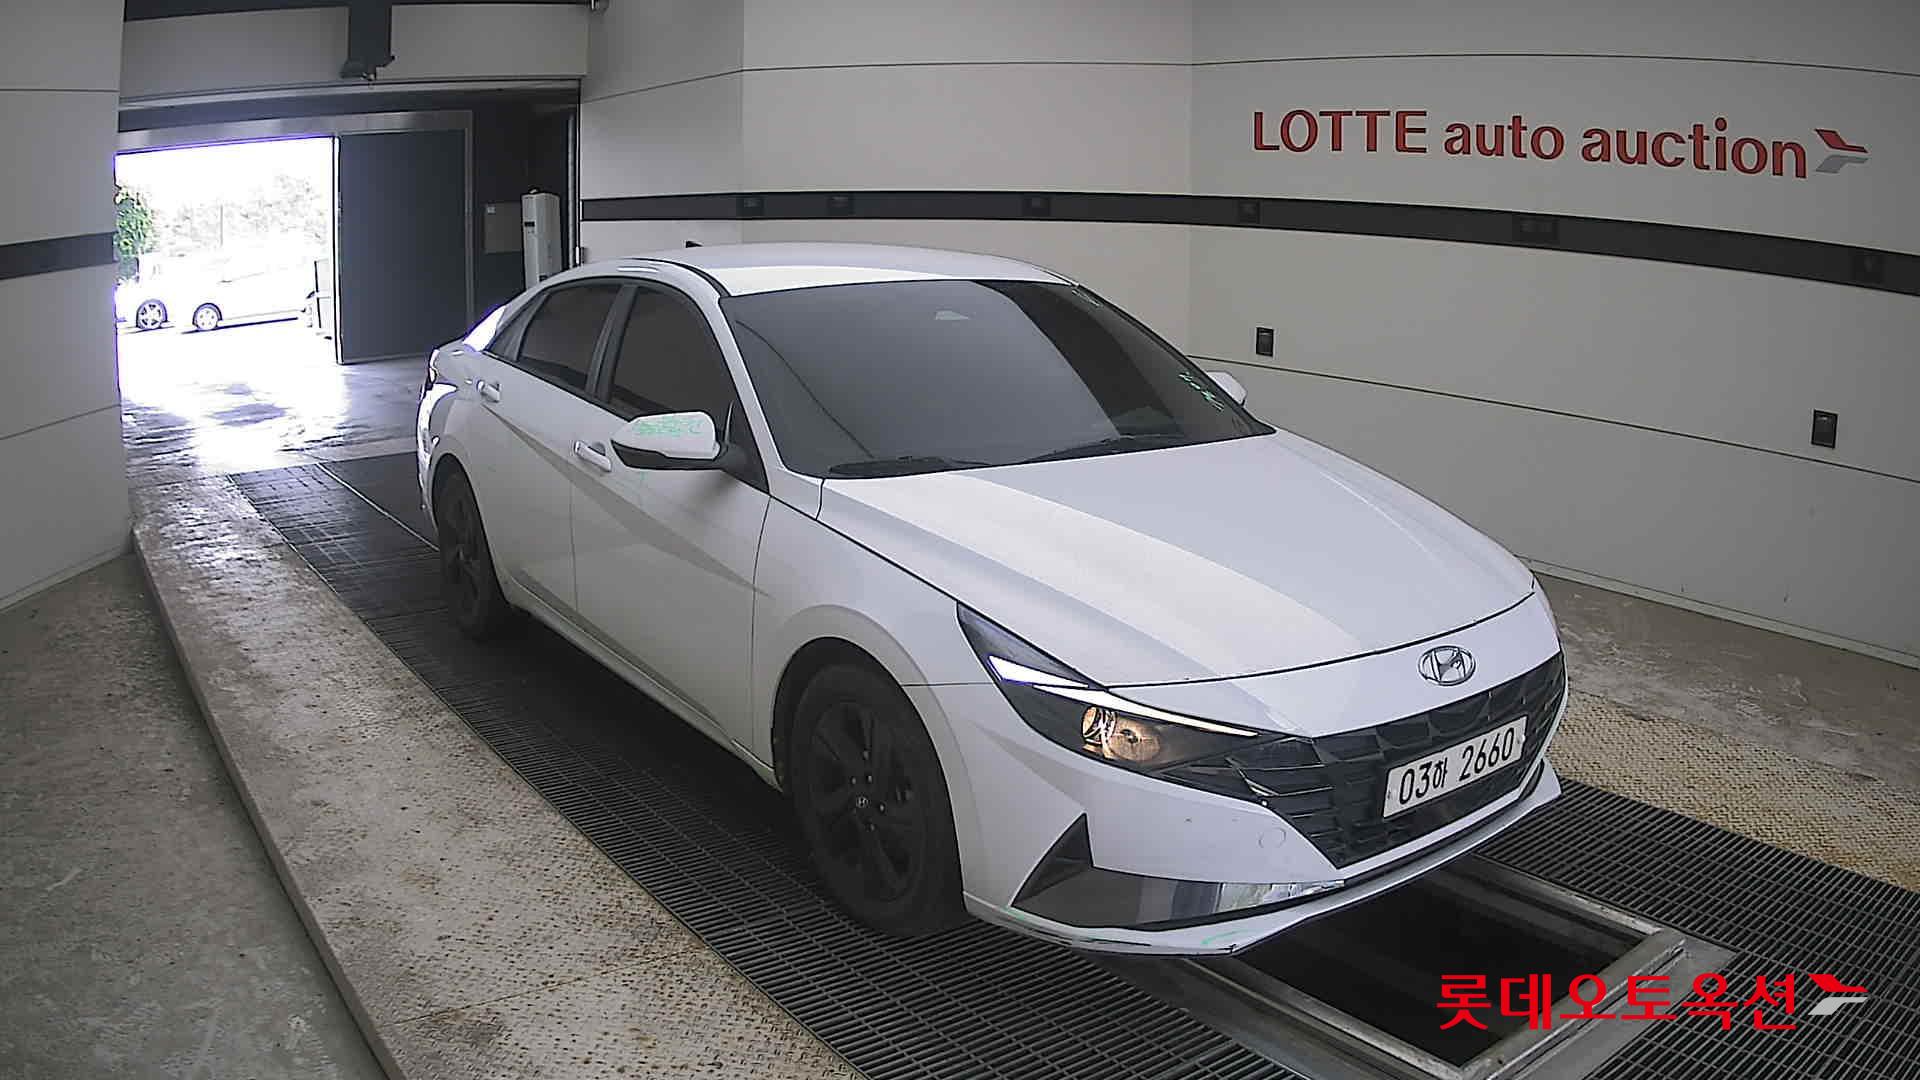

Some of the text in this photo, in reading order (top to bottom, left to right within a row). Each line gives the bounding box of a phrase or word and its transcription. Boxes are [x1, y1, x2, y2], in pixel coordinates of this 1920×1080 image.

[1253, 110, 1807, 179] LOTTE auto auction
[1399, 727, 1515, 805] 03하 2660
